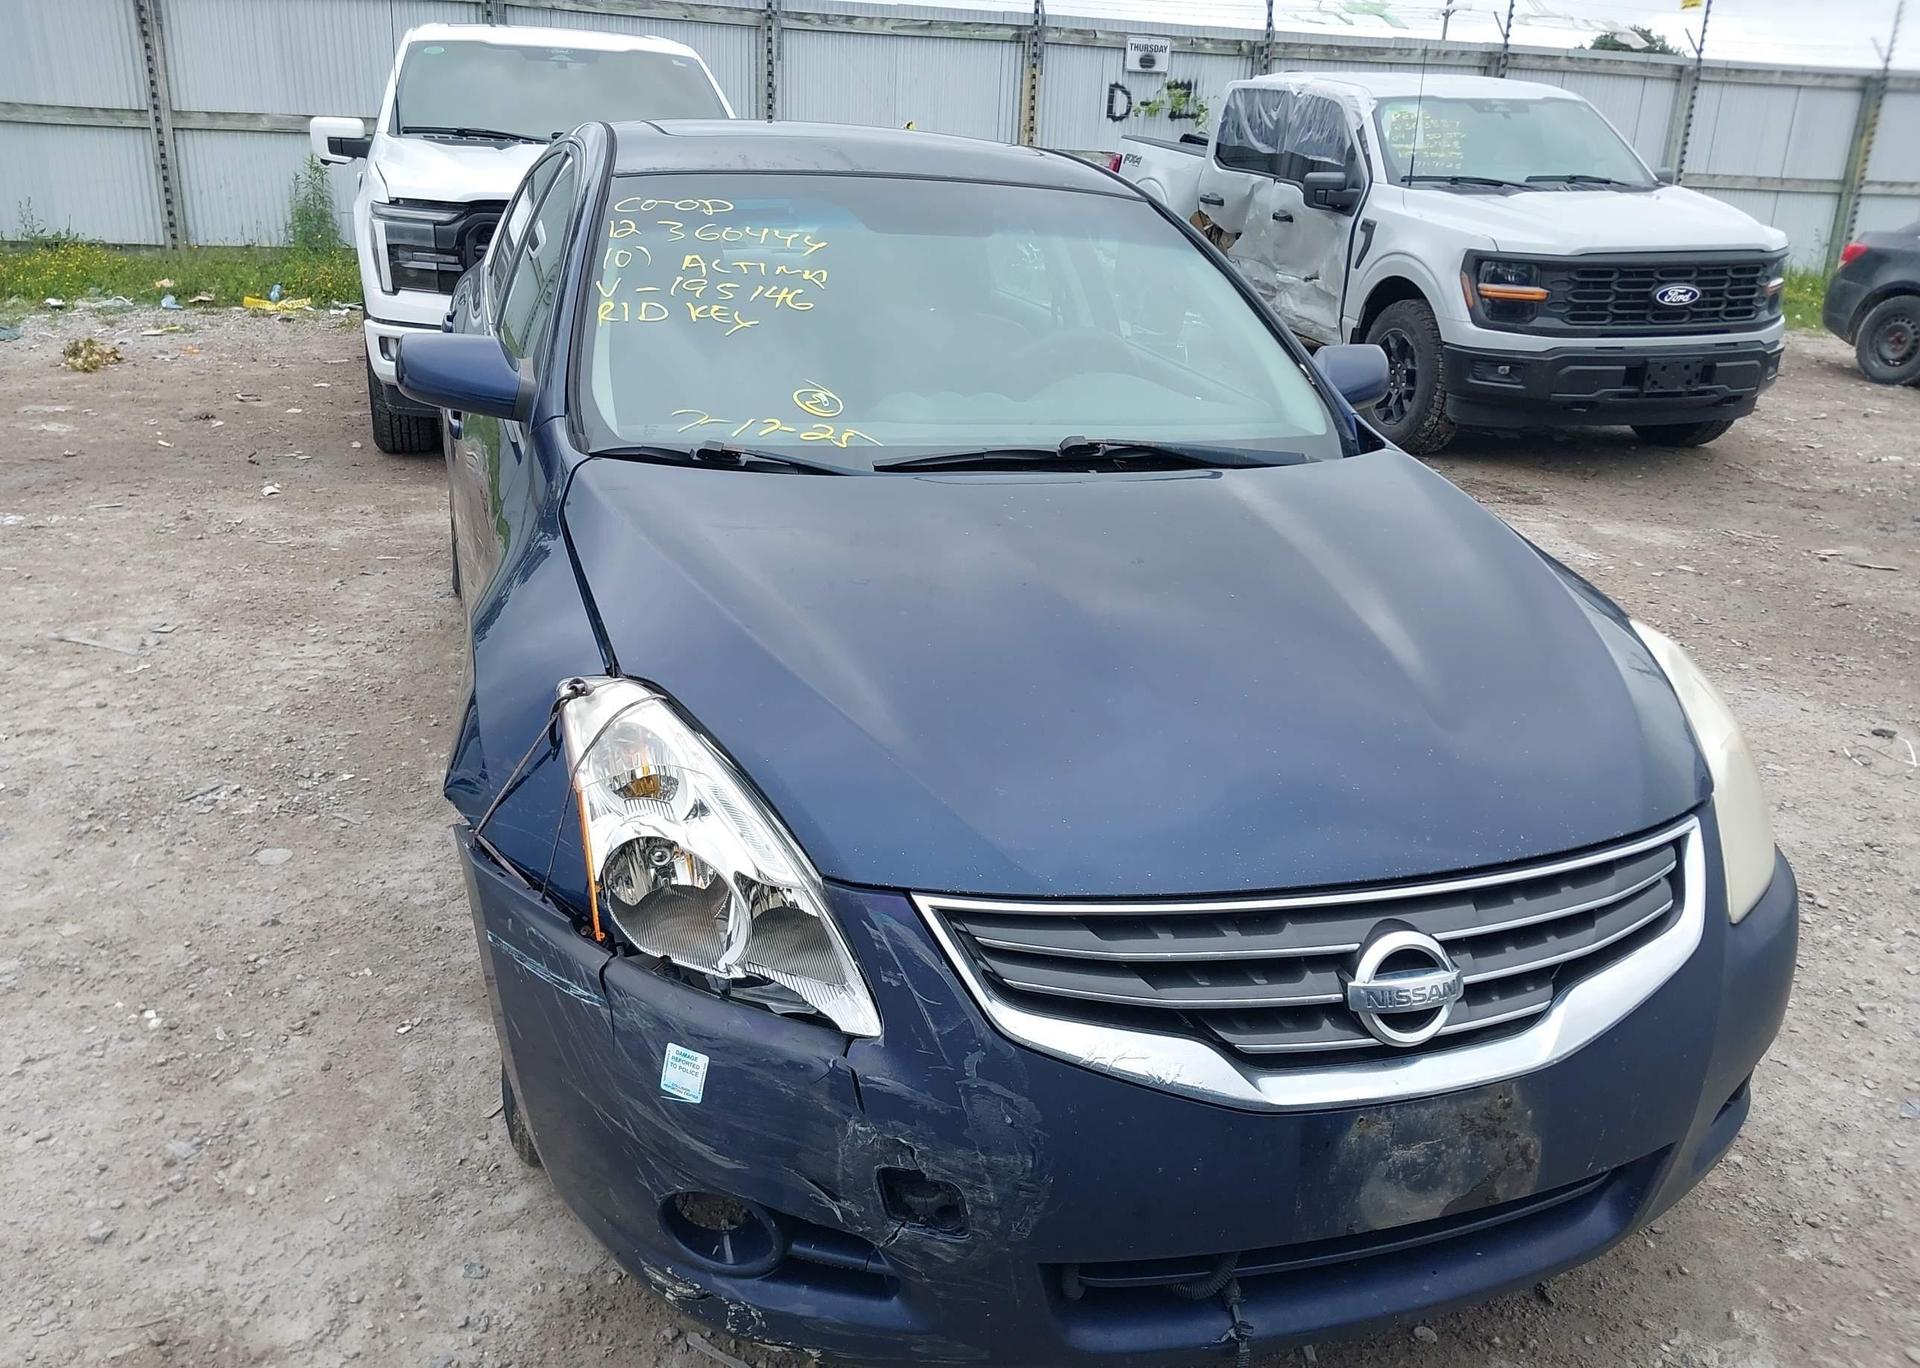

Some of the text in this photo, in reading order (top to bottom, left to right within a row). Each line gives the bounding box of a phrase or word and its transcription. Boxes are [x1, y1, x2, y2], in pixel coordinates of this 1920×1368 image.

[1130, 42, 1169, 54] THURSDAY
[1663, 288, 1693, 302] Ford
[686, 302, 760, 337] KEY
[1366, 979, 1457, 1009] NISSAN
[675, 1049, 699, 1062] DAMAGE
[670, 1061, 700, 1077] TO POLICE
[671, 1056, 701, 1070] REPORTED
